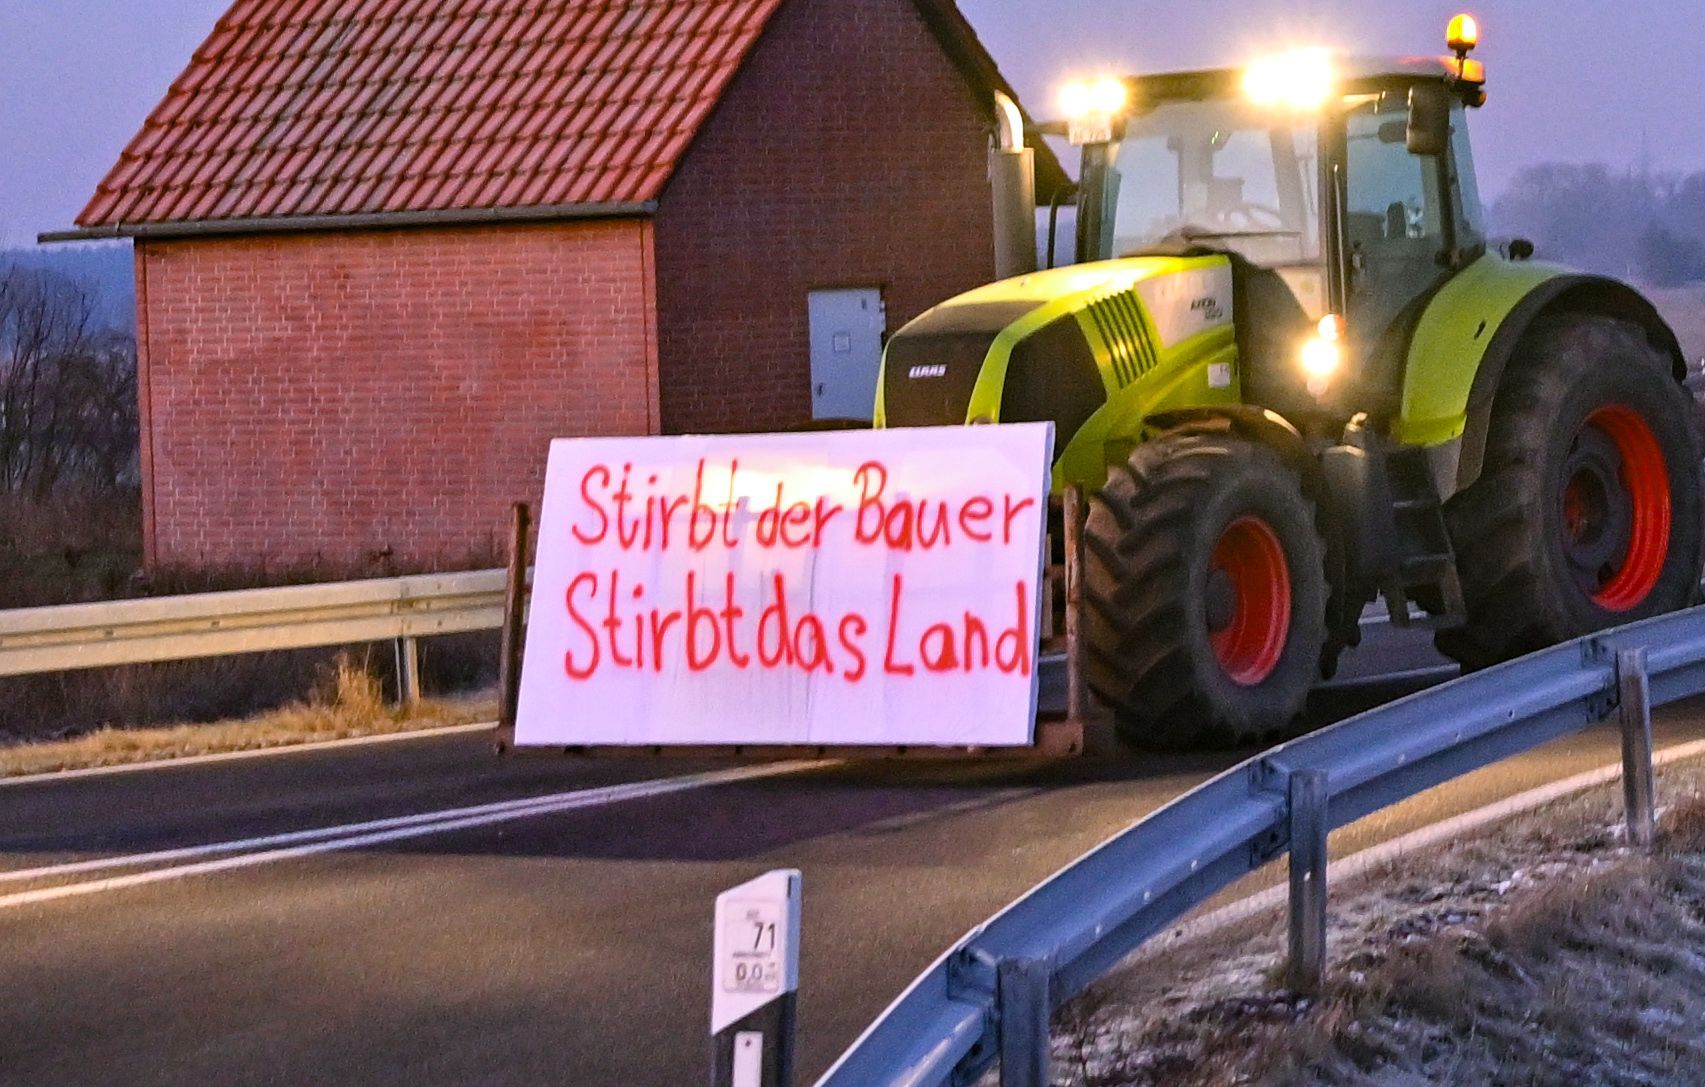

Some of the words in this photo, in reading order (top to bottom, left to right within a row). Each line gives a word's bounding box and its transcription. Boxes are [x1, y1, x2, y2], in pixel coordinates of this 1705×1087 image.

[572, 458, 738, 553] Stirbt
[756, 481, 844, 550] der
[854, 460, 1034, 552] Bauer
[884, 572, 1030, 677] Land
[754, 922, 775, 950] 71
